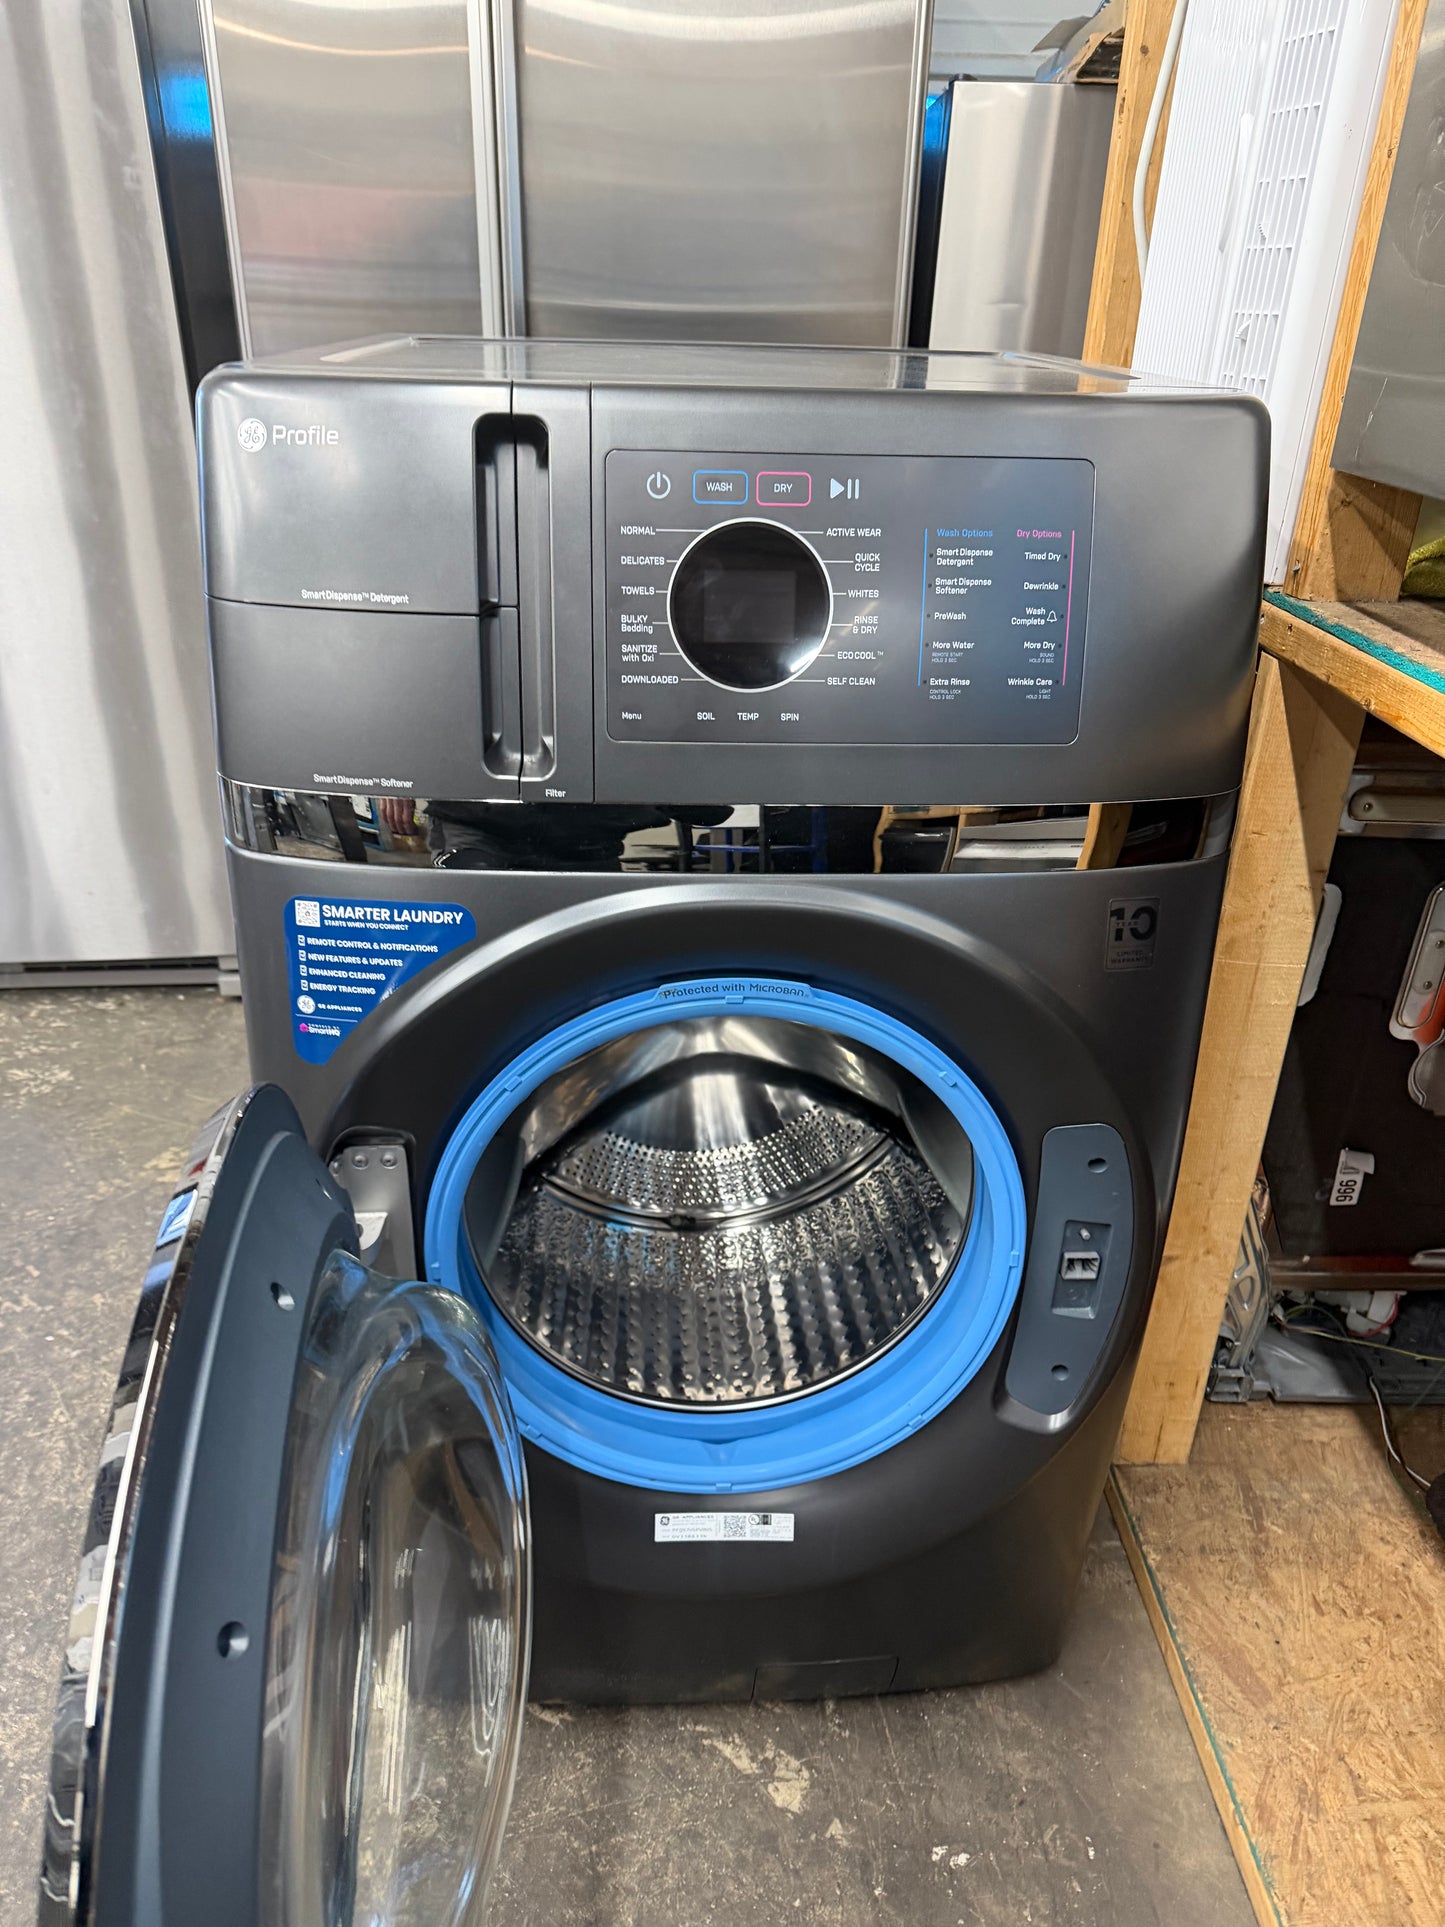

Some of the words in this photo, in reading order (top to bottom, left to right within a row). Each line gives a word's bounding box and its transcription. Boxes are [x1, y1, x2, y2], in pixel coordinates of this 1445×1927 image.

[272, 425, 339, 446] Profile
[706, 482, 733, 492] WASH
[773, 483, 793, 493] DRY
[620, 526, 656, 536] NORMAL
[826, 527, 856, 537] ACTIVE
[857, 527, 881, 537] WEAR
[936, 529, 960, 537] Wash
[962, 529, 993, 539] Options
[1016, 529, 1030, 539] Dry
[1032, 530, 1062, 539] Options
[620, 556, 665, 566] DELICATES
[855, 553, 881, 563] QUICK
[1024, 552, 1046, 560] Timed
[1047, 552, 1061, 562] Dry
[936, 558, 974, 567] Detergent
[854, 563, 881, 573] CYCLE
[621, 586, 655, 596] TOWELS
[935, 586, 968, 595] Softener
[1023, 582, 1059, 590] Dewrinkle
[370, 593, 409, 605] Detergent
[847, 589, 880, 599] WHITES
[934, 612, 967, 620] PreWash
[1025, 607, 1046, 615] Wash
[620, 614, 648, 624] BULKY
[853, 615, 879, 625] RINSE
[1011, 617, 1045, 627] Complete
[621, 624, 654, 634] Bedding
[852, 625, 860, 634] &
[860, 625, 878, 635] DRY
[621, 644, 658, 654] SANITIZE
[932, 641, 951, 649] More
[952, 641, 975, 649] Water
[1023, 641, 1042, 650] More
[1042, 641, 1055, 651] Dry
[621, 653, 640, 662] with
[641, 653, 655, 662] Oxi
[621, 675, 679, 684] DOWNLOADED
[826, 677, 848, 686] SELF
[848, 677, 876, 686] CLEAN
[929, 678, 949, 686] Extra
[950, 678, 971, 686] Rinse
[1007, 678, 1034, 686] Wrinkle
[1035, 678, 1053, 686] Care
[621, 711, 642, 721] Menu
[696, 711, 715, 721] SOIL
[737, 712, 759, 721] TEMP
[780, 712, 800, 722] SPIN
[380, 777, 414, 788] Softener
[545, 788, 567, 798] Filter
[322, 904, 390, 921] SMARTER
[393, 909, 464, 925] LAUNDRY
[323, 919, 347, 927] STARTS
[347, 920, 365, 929] WHEN
[365, 922, 379, 930] YOU
[379, 923, 409, 931] CONNECT
[1110, 907, 1157, 941] 10
[306, 937, 336, 947] REMOTE
[336, 939, 372, 950] CONTROL
[380, 942, 439, 953] NOTIFICATIONS
[307, 952, 325, 962] NEW
[325, 954, 362, 965] FEATURES
[361, 957, 369, 965] &
[369, 957, 404, 967] UPDATES
[308, 967, 348, 978] ENHANCED
[348, 970, 386, 981] CLEANING
[309, 982, 337, 992] ENERGY
[337, 984, 376, 995] TRACKING
[663, 983, 719, 999] Protected
[721, 983, 745, 992] with
